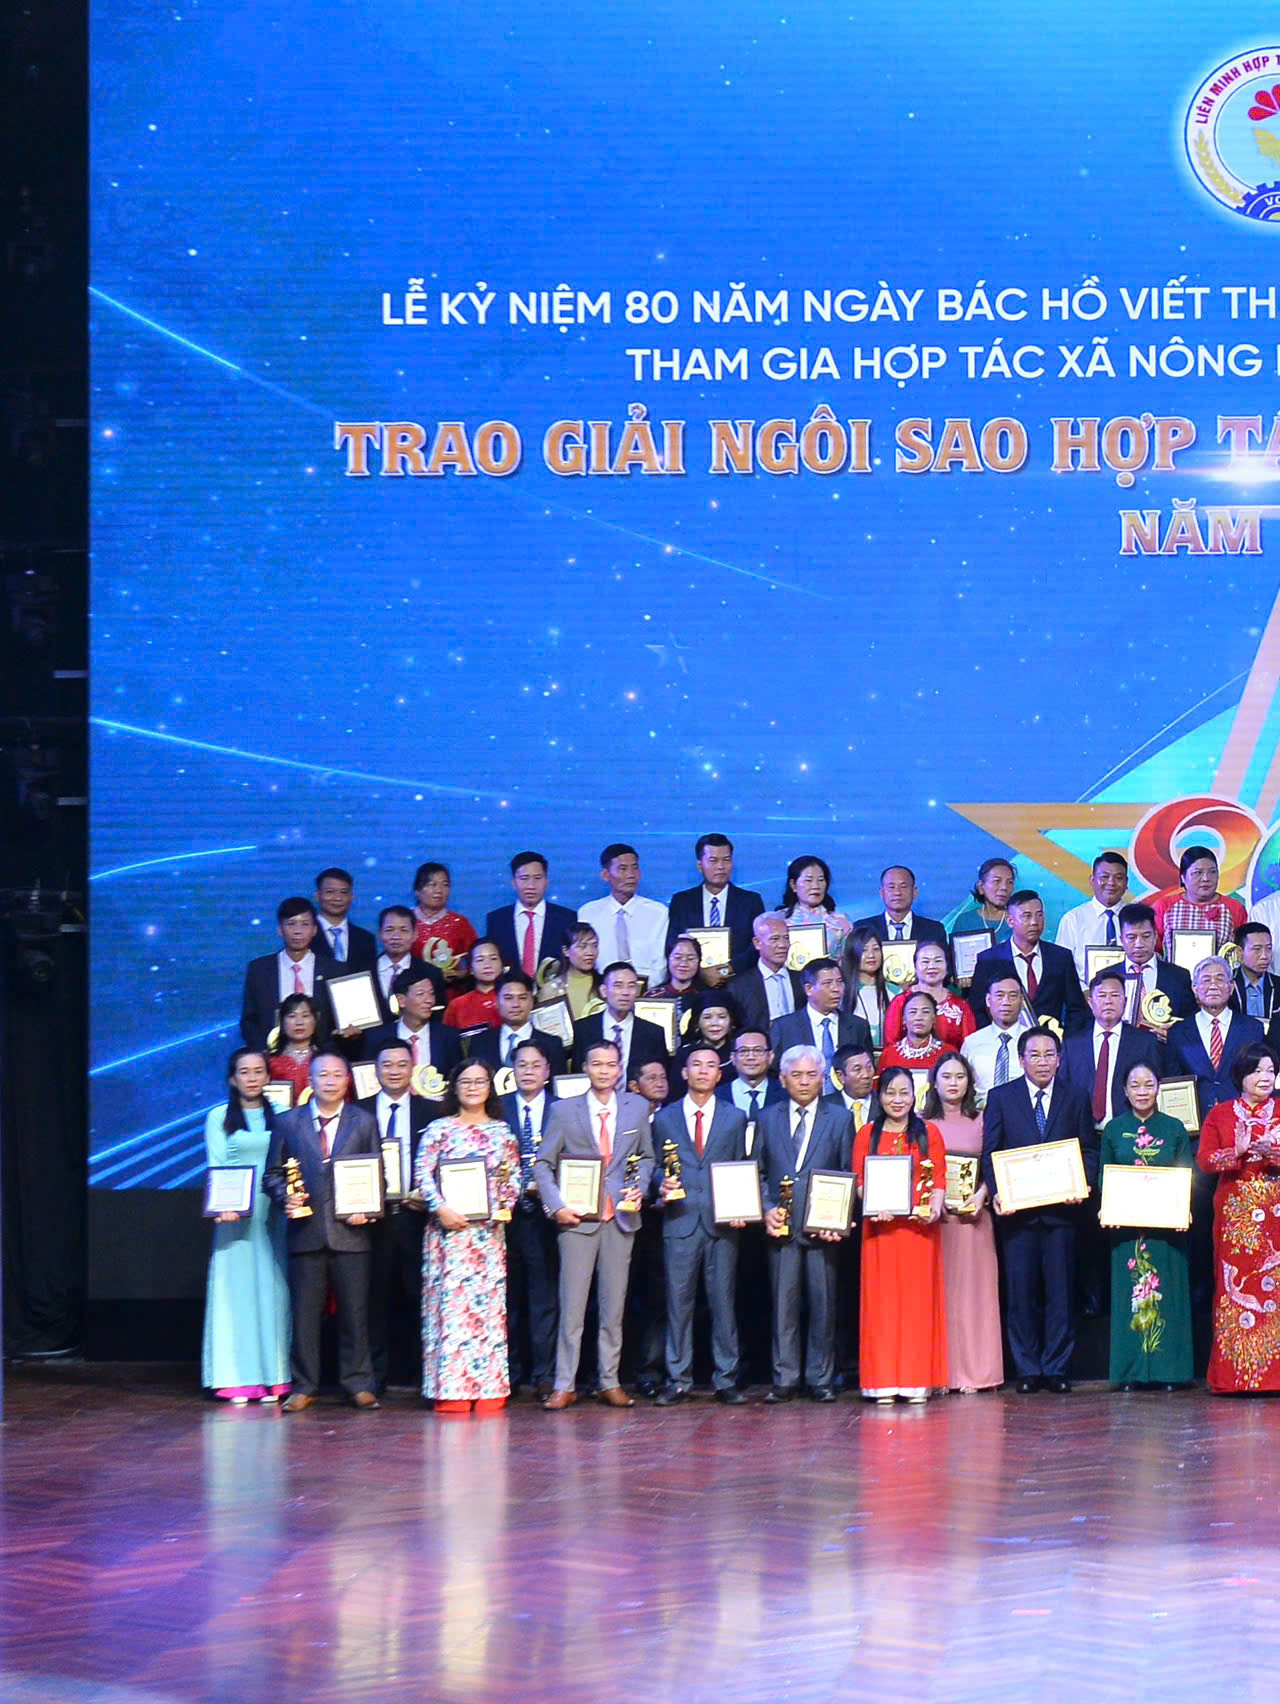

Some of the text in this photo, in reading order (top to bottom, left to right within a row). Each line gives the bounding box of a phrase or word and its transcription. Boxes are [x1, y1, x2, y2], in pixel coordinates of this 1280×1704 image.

[1195, 96, 1215, 124] LIÊN
[1209, 67, 1241, 96] MINH
[1242, 55, 1270, 72] HỢP
[382, 277, 428, 326] LỄ
[441, 281, 496, 325] KỶ
[509, 283, 612, 333] NIỆM
[625, 290, 680, 324] 80
[693, 282, 789, 324] NĂM
[804, 280, 925, 323] NGÀY
[938, 279, 1028, 321] BÁC
[1041, 275, 1108, 321] HỒ
[1119, 275, 1211, 320] VIẾT
[625, 348, 749, 381] THAM
[762, 347, 841, 381] GIA
[854, 343, 947, 389] HỢP
[958, 337, 1045, 379] TÁC
[1057, 336, 1116, 378] XÃ
[1129, 335, 1264, 378] NÔNG
[334, 420, 522, 477] TRAO
[543, 402, 687, 476] GIẢI
[708, 403, 873, 475] NGÔI
[895, 416, 1029, 474] SAO
[1050, 412, 1196, 488] HỢP
[1119, 498, 1263, 556] NĂM
